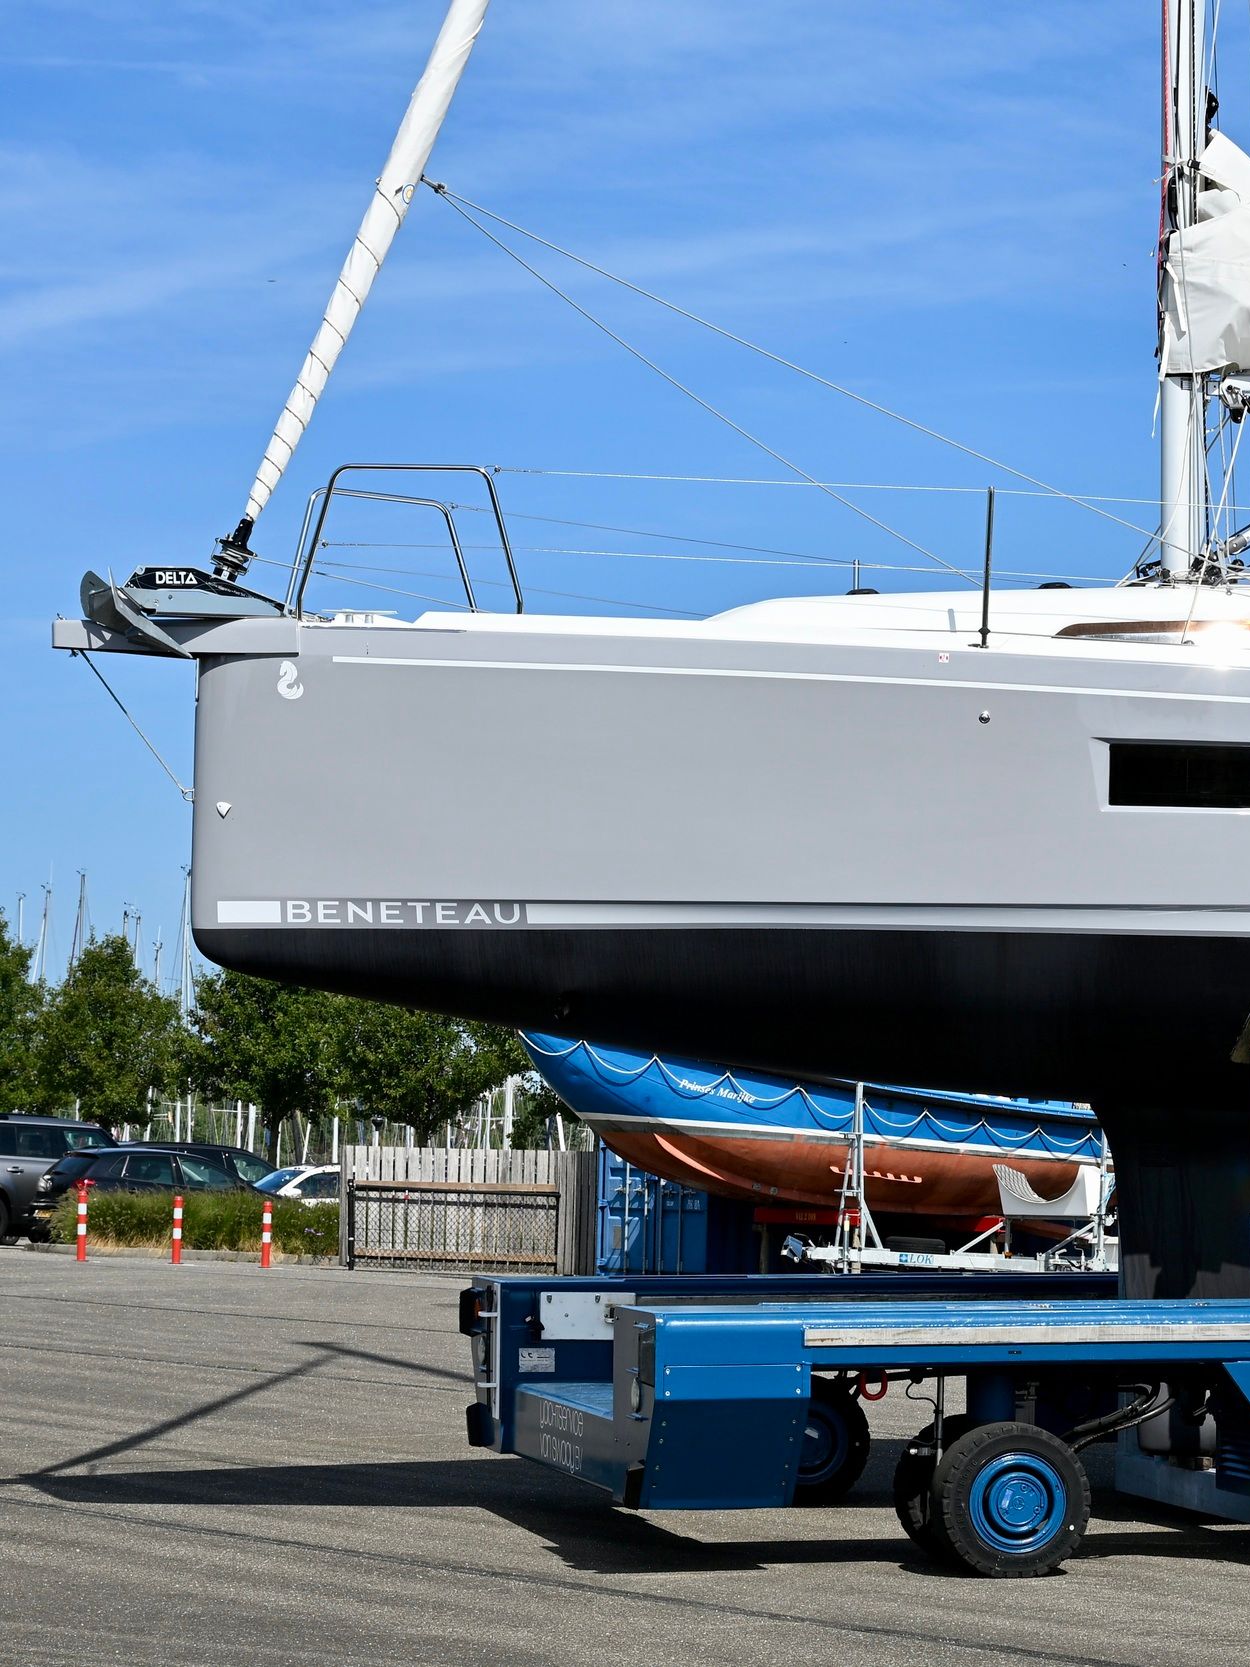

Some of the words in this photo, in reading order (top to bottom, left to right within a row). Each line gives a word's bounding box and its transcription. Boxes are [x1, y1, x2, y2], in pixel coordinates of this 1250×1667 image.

[155, 571, 198, 585] DELTA
[286, 900, 521, 925] BENETEAU
[679, 1079, 716, 1095] Prinses
[716, 1087, 757, 1104] Marijke
[910, 1253, 933, 1265] LOK
